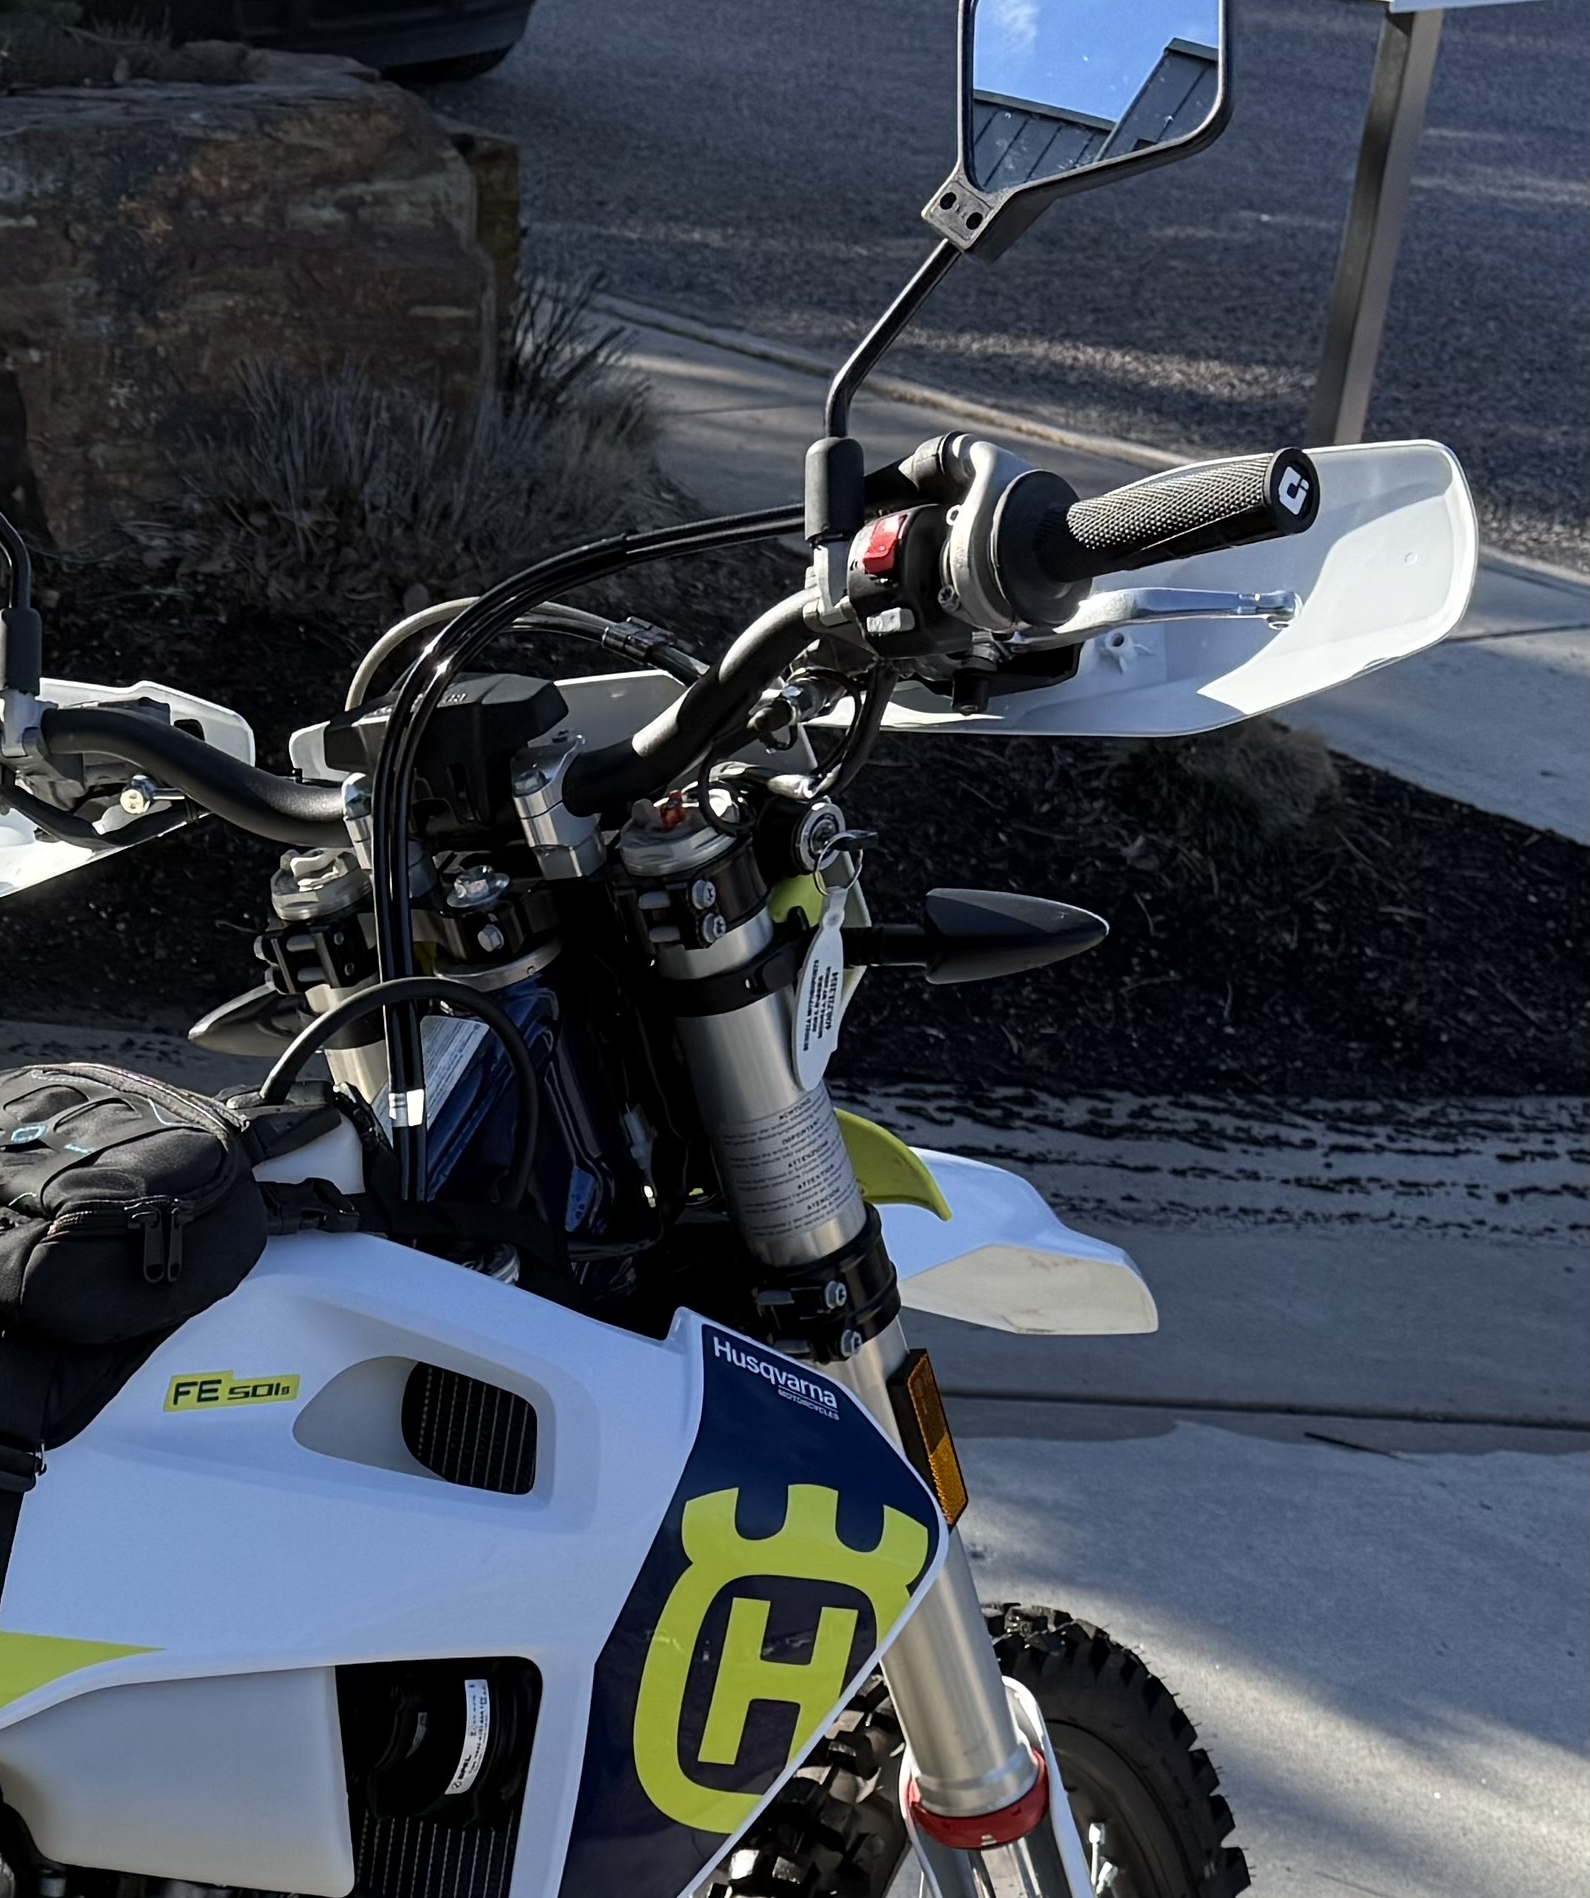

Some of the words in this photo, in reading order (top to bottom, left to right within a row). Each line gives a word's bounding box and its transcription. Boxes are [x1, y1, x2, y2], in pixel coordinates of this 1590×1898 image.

[713, 1336, 838, 1409] Husqvarna
[173, 1379, 222, 1405] FE
[778, 1388, 840, 1421] MOTORCYCLES
